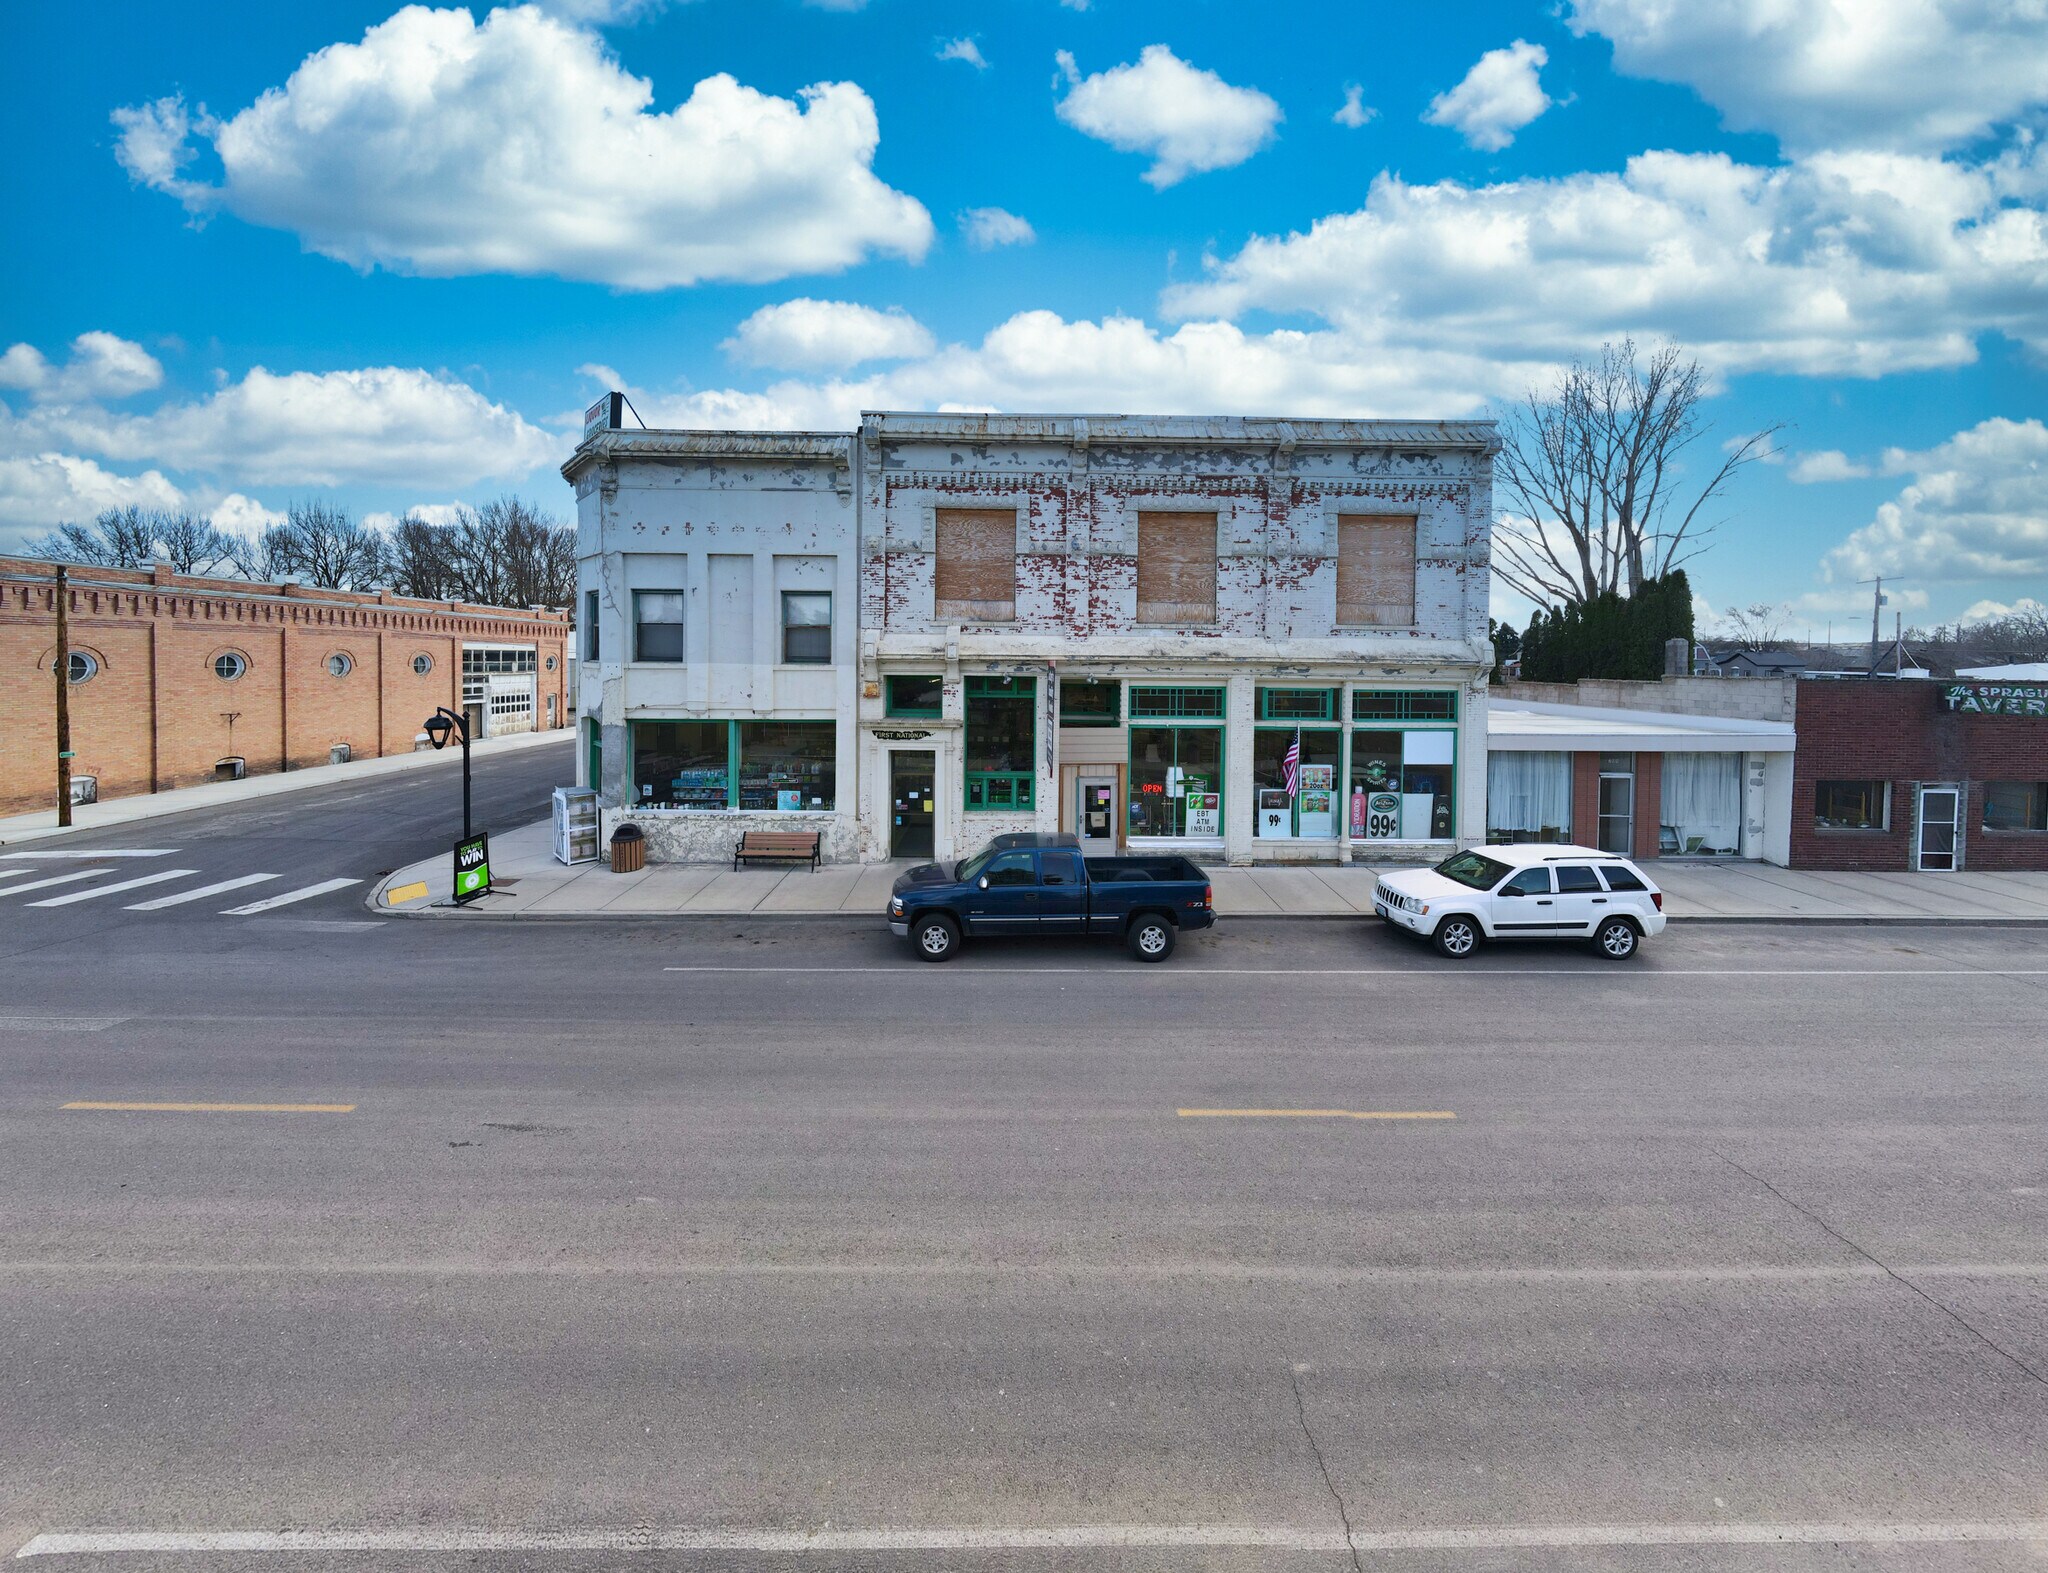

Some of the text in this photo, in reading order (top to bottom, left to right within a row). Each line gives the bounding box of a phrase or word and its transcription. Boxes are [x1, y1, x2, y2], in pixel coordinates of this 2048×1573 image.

[1950, 686, 1974, 697] The
[1367, 759, 1387, 767] WINES
[1366, 777, 1387, 786] SPIRITS
[1142, 784, 1162, 793] OPEN
[1190, 825, 1215, 833] INSIDE
[1370, 814, 1397, 837] 99¢
[460, 849, 483, 866] WIN
